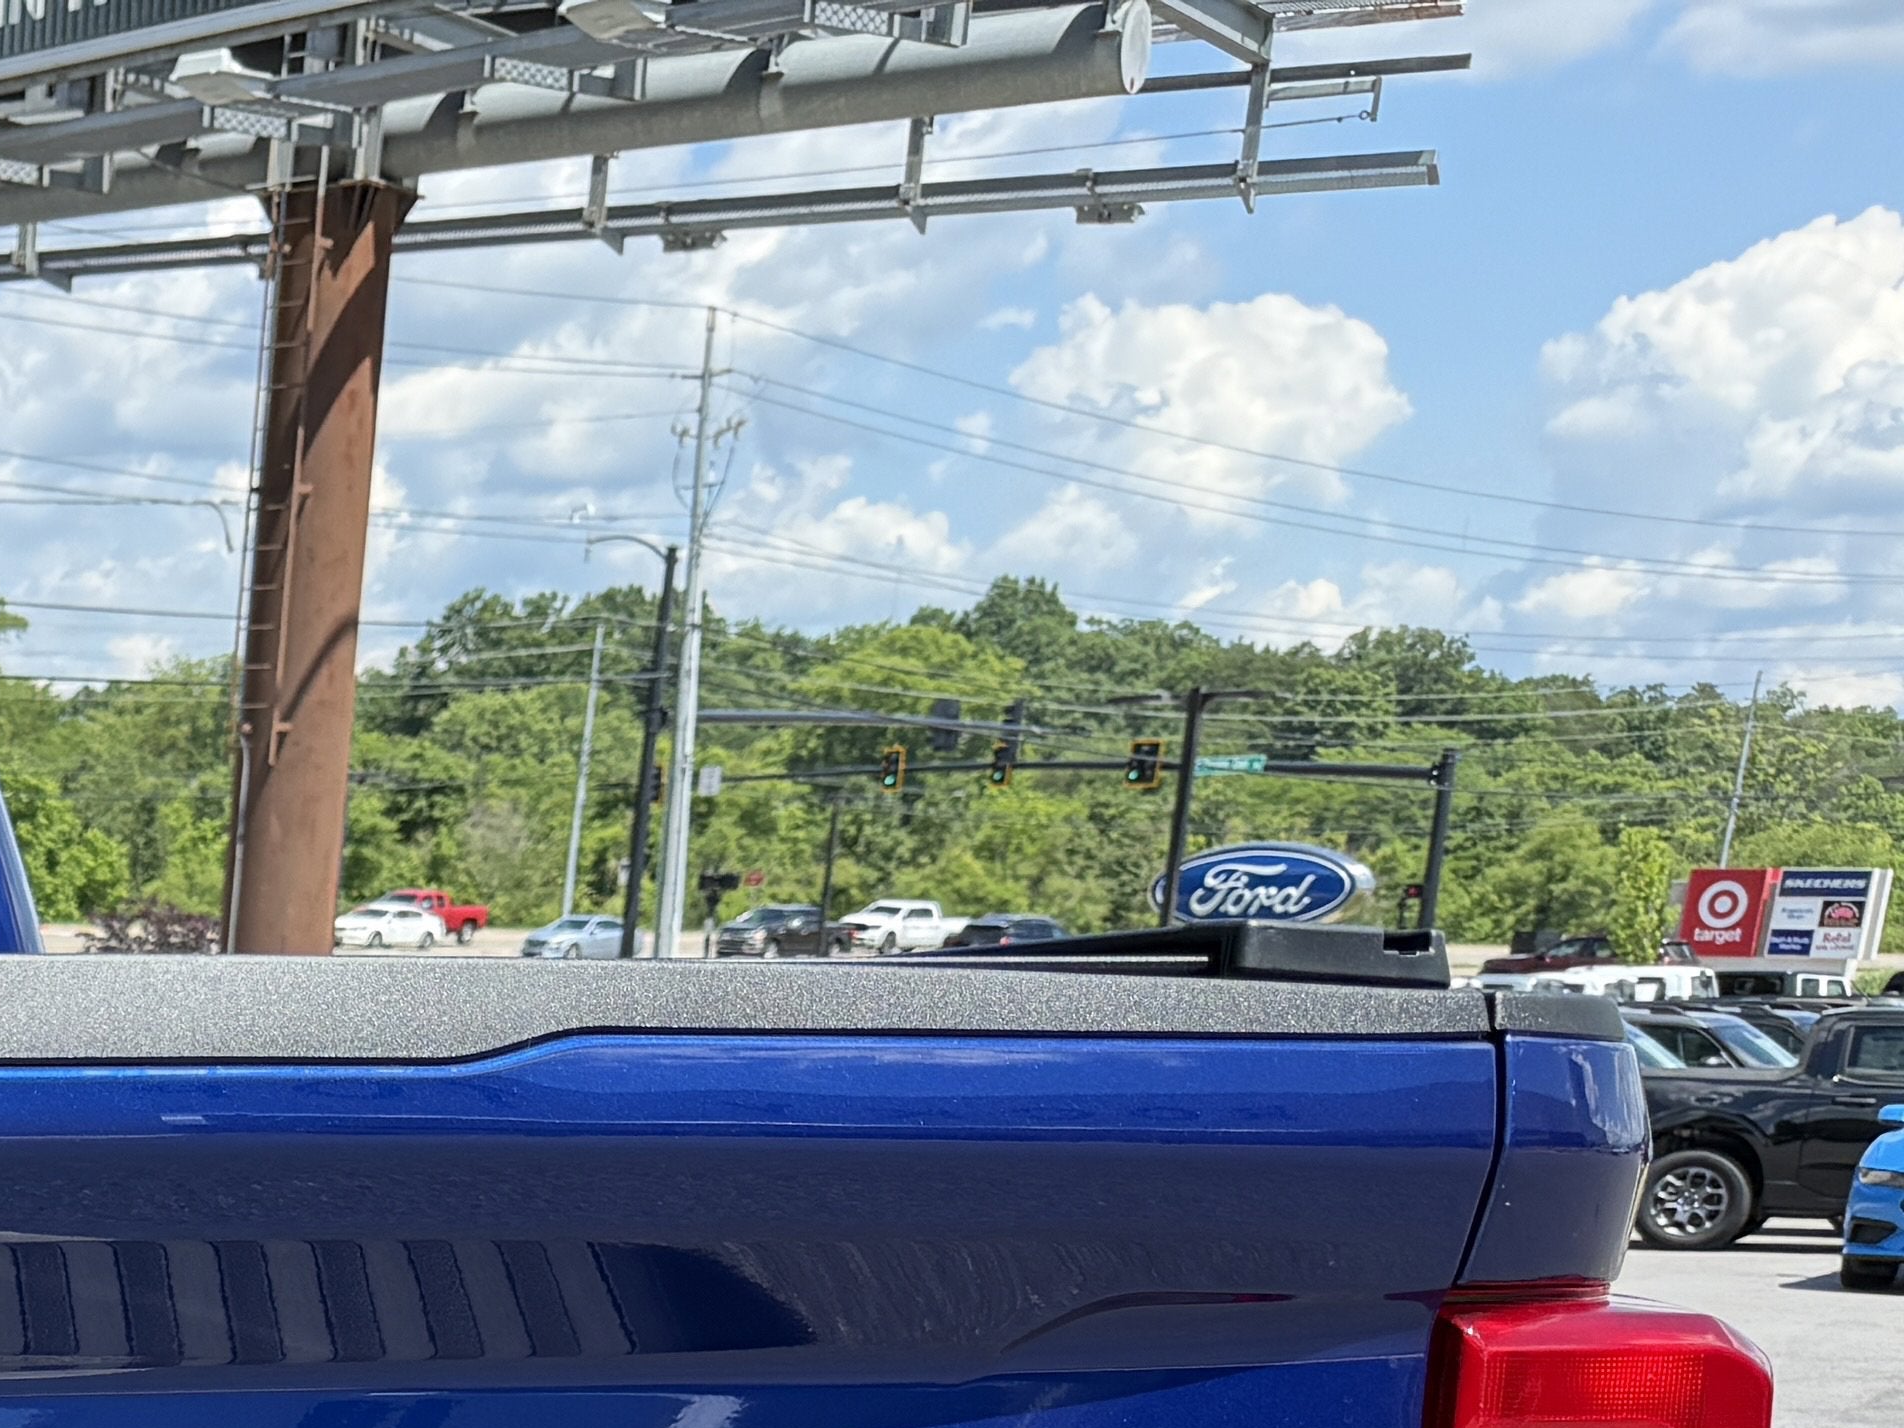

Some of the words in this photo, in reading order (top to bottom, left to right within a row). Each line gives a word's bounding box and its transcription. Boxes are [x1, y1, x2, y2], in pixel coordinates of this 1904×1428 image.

[1188, 862, 1317, 917] Ford
[1782, 878, 1868, 890] SKECHERS
[1694, 927, 1743, 945] target
